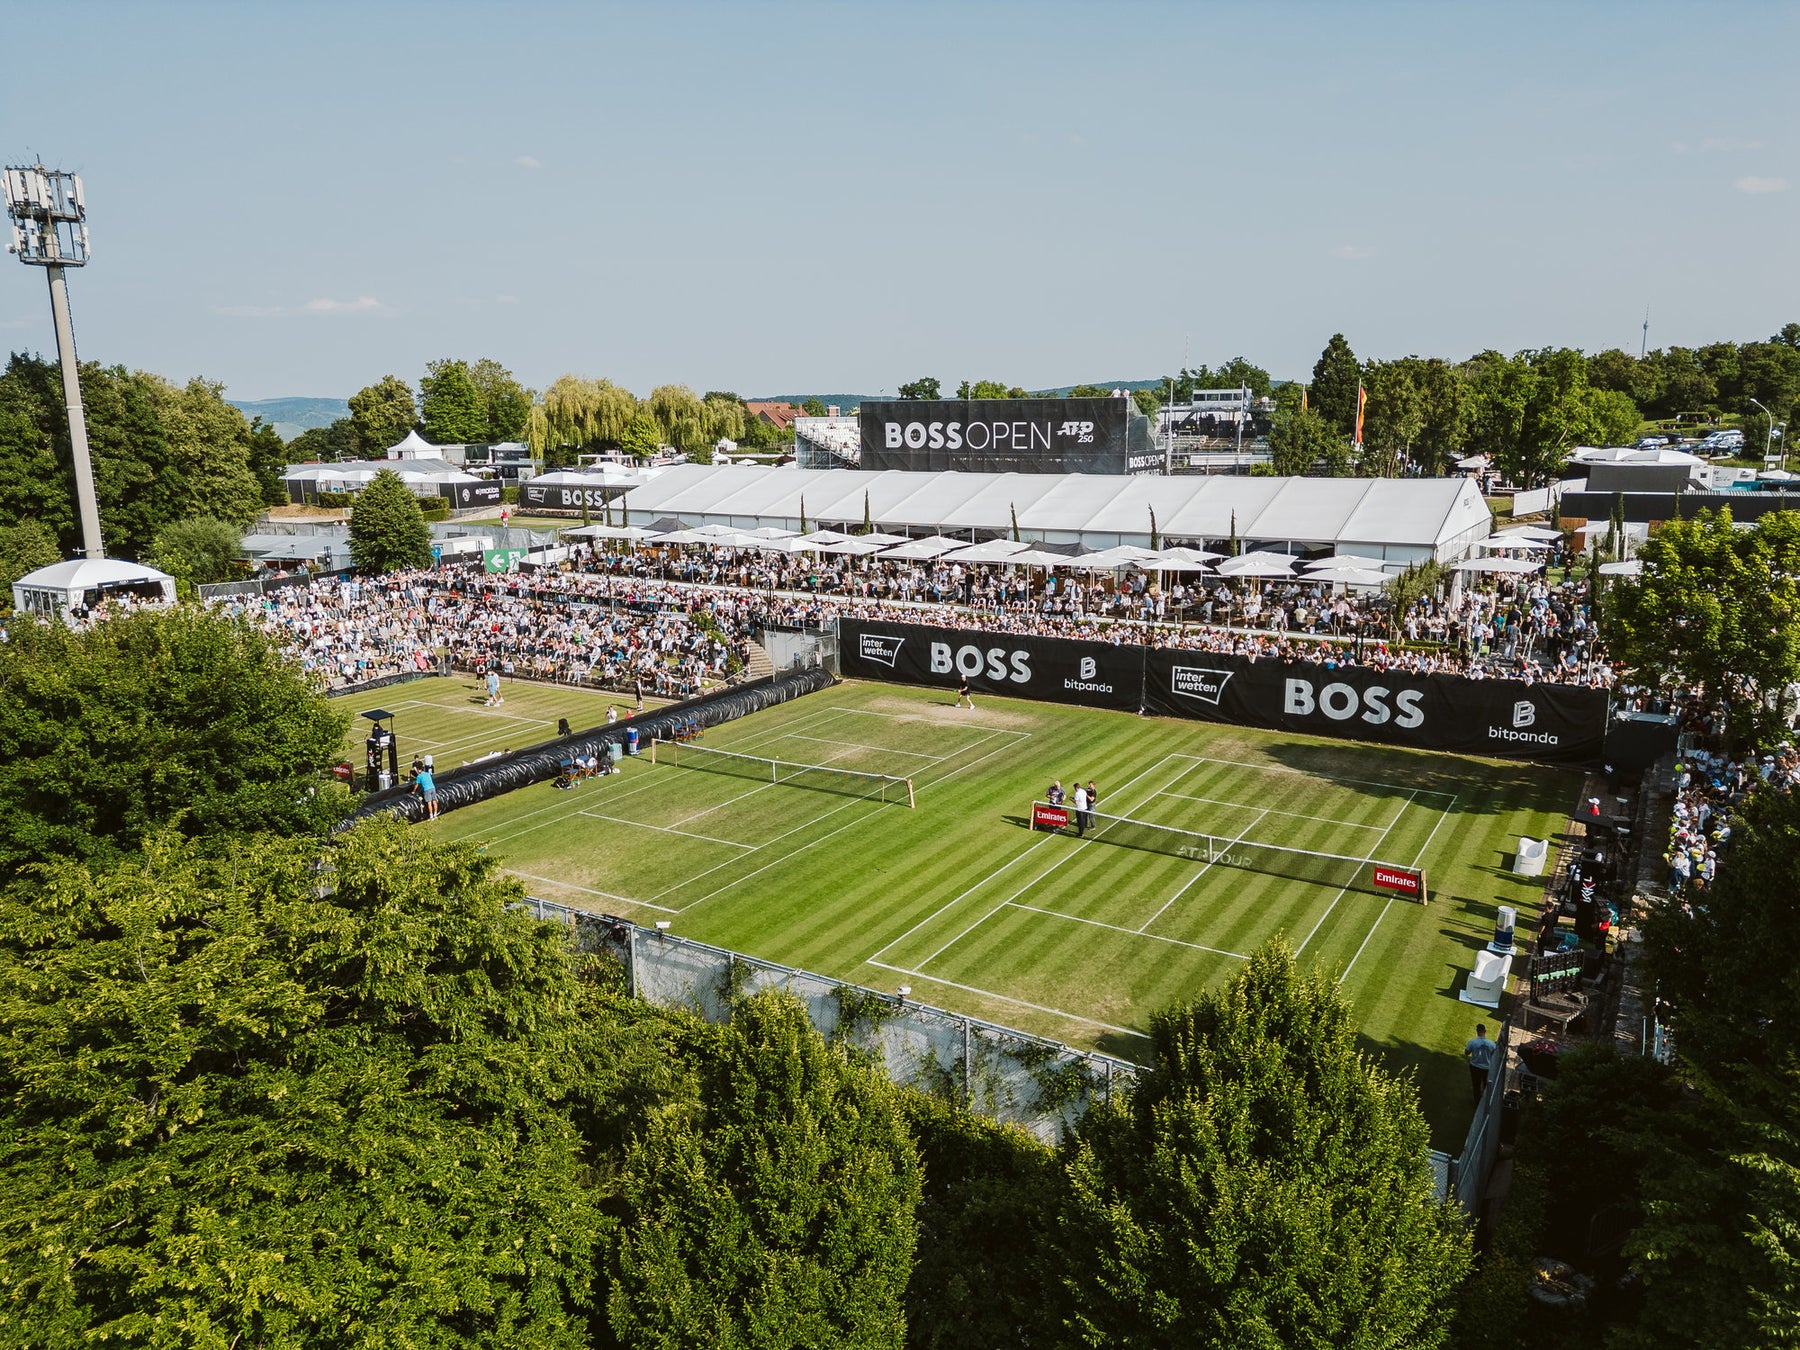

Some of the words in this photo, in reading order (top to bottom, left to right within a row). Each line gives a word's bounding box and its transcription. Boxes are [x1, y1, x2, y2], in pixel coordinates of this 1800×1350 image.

[885, 422, 962, 449] BOSS
[966, 421, 1051, 450] OPEN
[1056, 421, 1094, 436] ATP
[1077, 434, 1094, 443] 250
[1129, 456, 1144, 468] BOSS
[1144, 455, 1159, 467] OPEN
[561, 489, 603, 507] BOSS
[863, 636, 884, 648] inter
[864, 647, 893, 657] wetten
[931, 641, 1032, 684] BOSS
[1176, 668, 1205, 683] inter
[1064, 678, 1113, 693] bitpanda
[1177, 681, 1218, 693] wetten
[1284, 678, 1425, 728] BOSS
[1488, 726, 1559, 745] bitpanda
[1036, 810, 1067, 822] Emirates
[1376, 872, 1416, 888] Emirates
